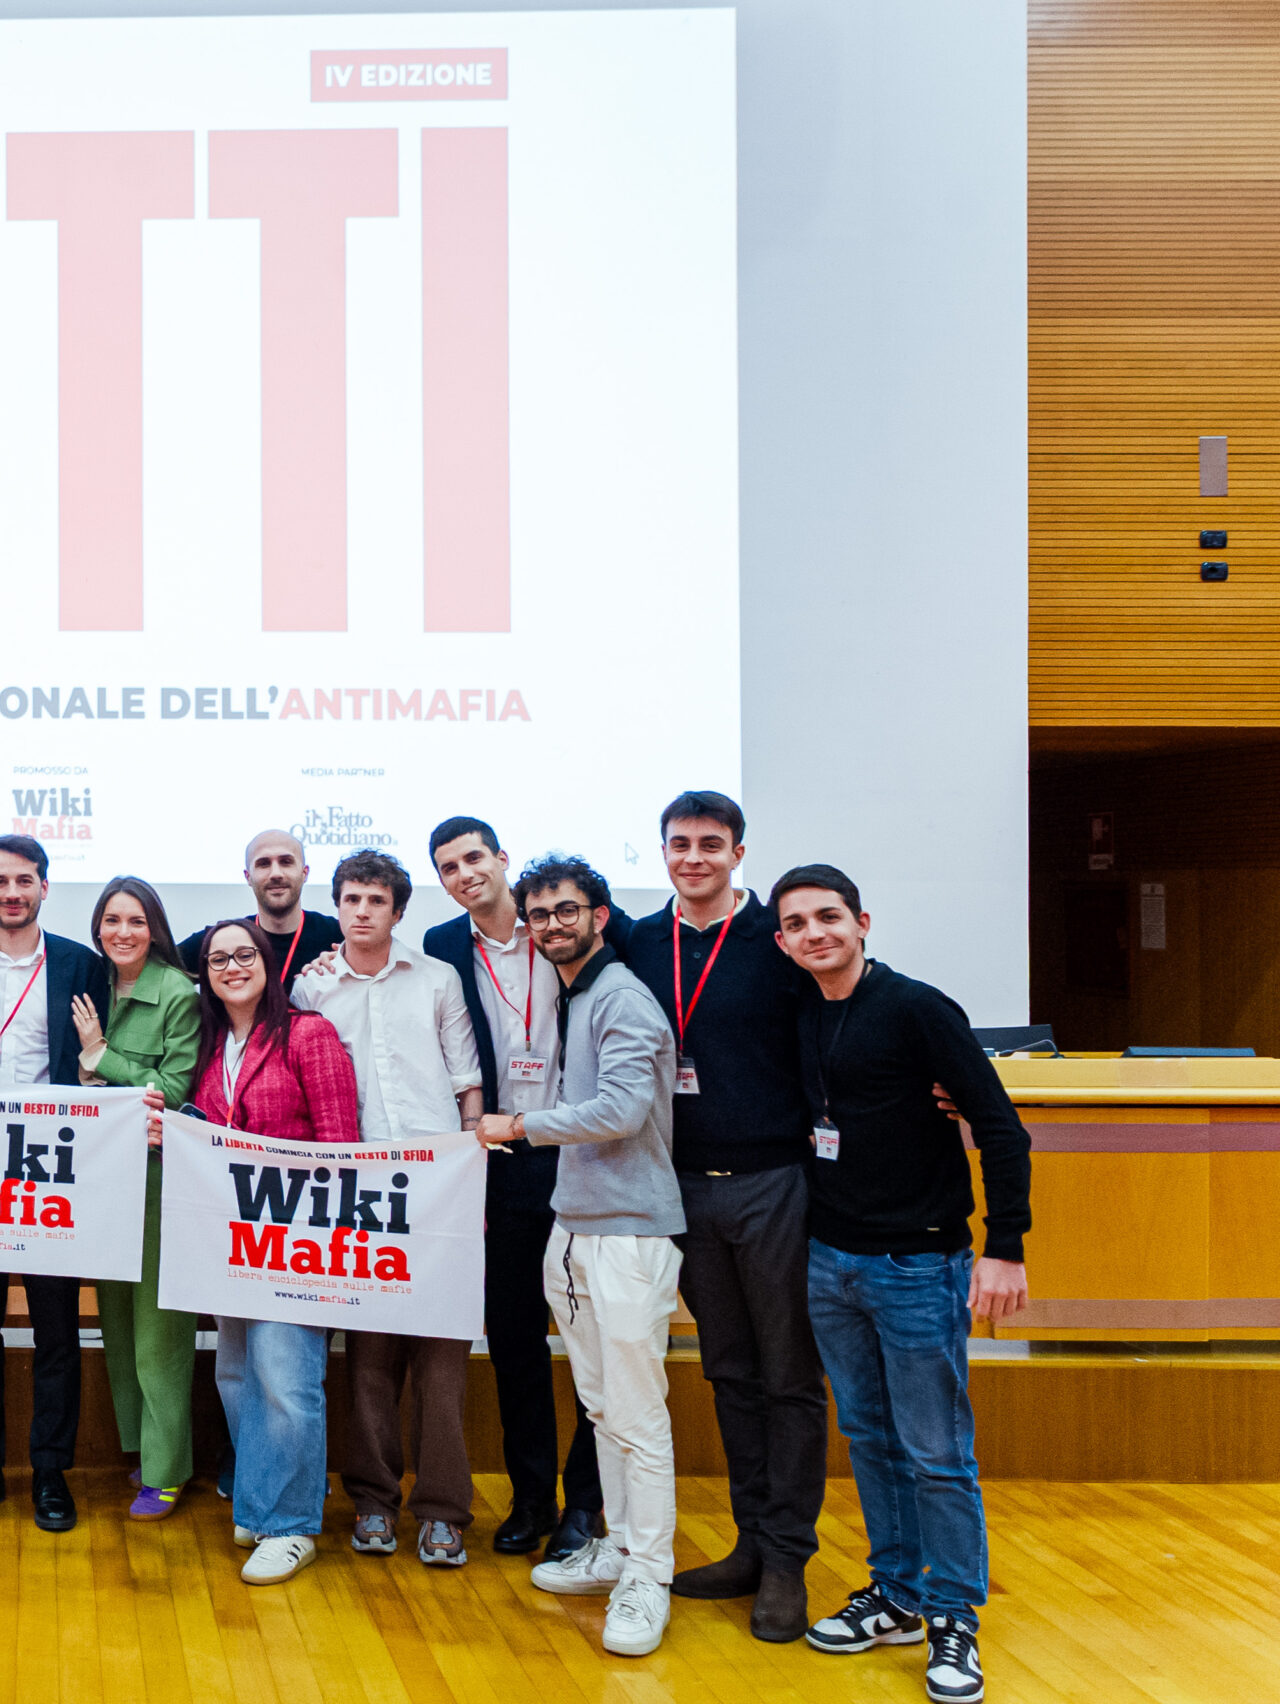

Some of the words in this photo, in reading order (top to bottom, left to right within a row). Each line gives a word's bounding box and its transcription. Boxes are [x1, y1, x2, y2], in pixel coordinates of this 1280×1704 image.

[325, 64, 354, 87] IV
[361, 63, 492, 87] EDIZIONE
[13, 766, 71, 775] PROMOSSO
[73, 766, 88, 775] DA
[301, 768, 334, 777] MEDIA
[337, 768, 385, 777] PARTNER
[12, 787, 92, 817] Wiki
[12, 815, 92, 840] Mafia
[328, 806, 373, 828] Fatto
[511, 1061, 544, 1070] STAFF
[8, 1102, 21, 1114] UN
[23, 1103, 56, 1115] GESTO
[58, 1104, 68, 1116] DI
[70, 1104, 99, 1117] SFIDA
[211, 1135, 223, 1147] LA
[265, 1146, 313, 1158] COMINCIA
[391, 1150, 401, 1161] DI
[403, 1149, 434, 1162] SFIDA
[229, 1162, 410, 1234] Wiki
[10, 1229, 39, 1238] sulle
[45, 1231, 75, 1240] mafie
[228, 1221, 411, 1282] Mafia
[227, 1269, 263, 1281] libera
[267, 1275, 338, 1289] enciclopedia
[342, 1281, 374, 1292] sulle
[380, 1285, 413, 1295] mafie
[274, 1290, 361, 1306] www.wikimafia.it
